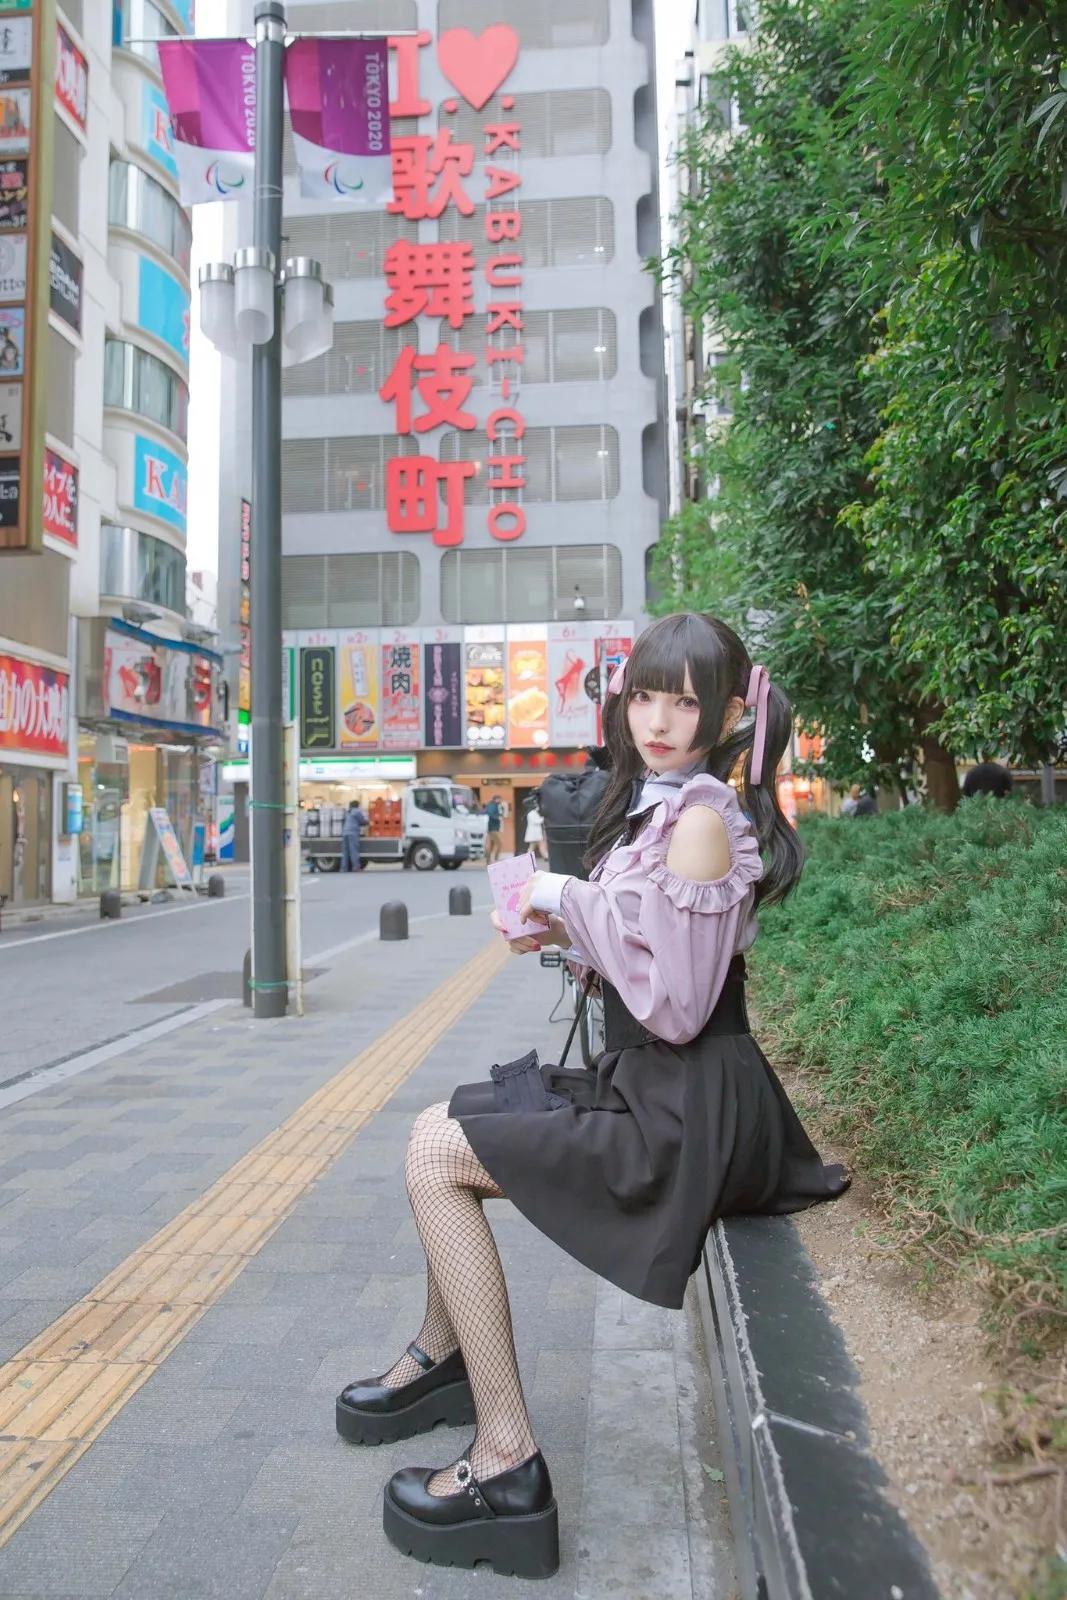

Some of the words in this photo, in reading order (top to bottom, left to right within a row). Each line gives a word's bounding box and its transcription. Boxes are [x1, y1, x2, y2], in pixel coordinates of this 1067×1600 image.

[365, 53, 380, 107] TOKYO
[367, 111, 383, 151] 2020
[378, 127, 477, 547] 歌舞伎町
[484, 123, 526, 541] KABUKI-CHO
[391, 646, 411, 694] 焼肉
